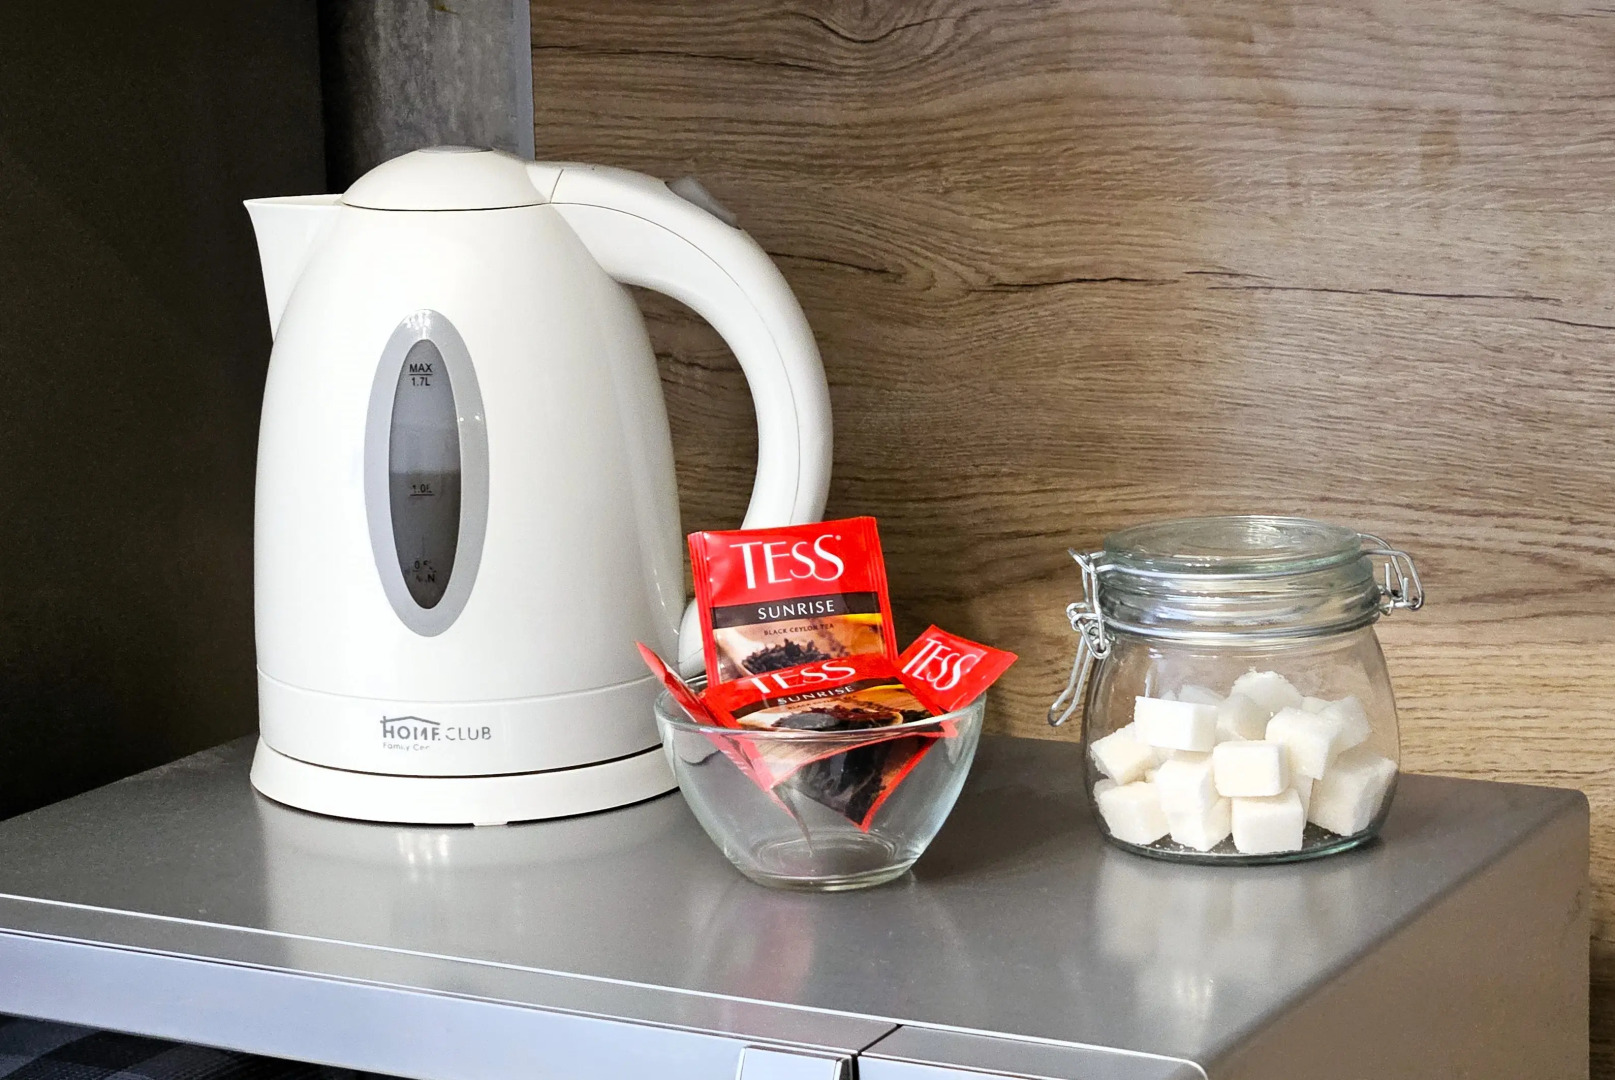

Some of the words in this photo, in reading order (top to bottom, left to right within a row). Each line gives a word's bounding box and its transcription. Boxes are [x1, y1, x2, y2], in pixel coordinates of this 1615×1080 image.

[409, 364, 432, 373] MAX
[411, 377, 430, 386] 1.7L
[729, 534, 845, 589] TESS
[757, 599, 835, 620] SUNRISE
[790, 625, 818, 633] CEYLON
[901, 638, 978, 691] TESS
[745, 660, 856, 694] TESS
[777, 685, 854, 705] SUNRISE
[445, 726, 492, 741] CLUB
